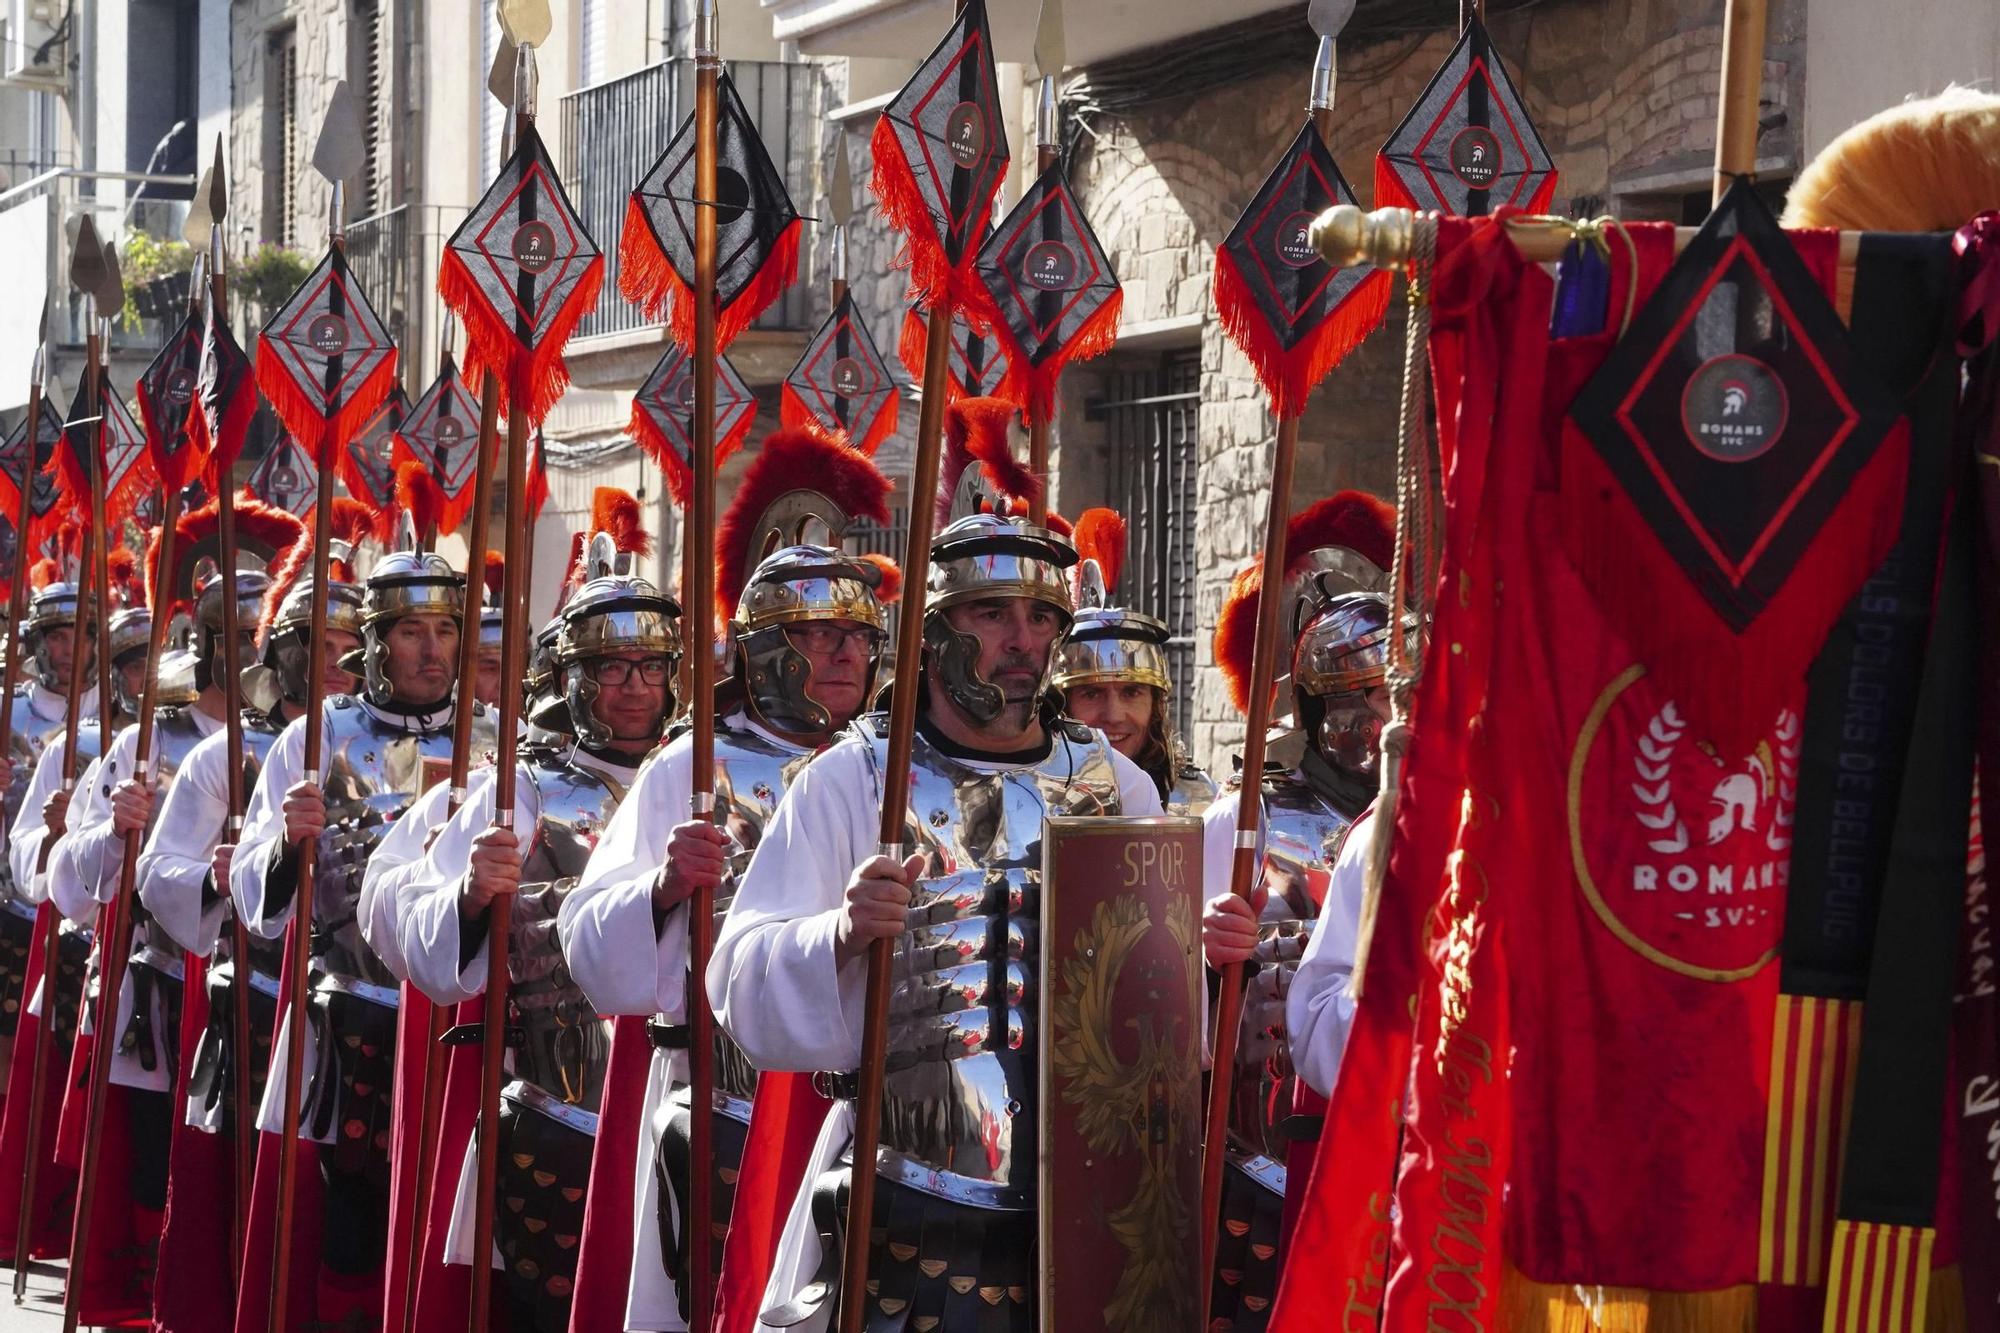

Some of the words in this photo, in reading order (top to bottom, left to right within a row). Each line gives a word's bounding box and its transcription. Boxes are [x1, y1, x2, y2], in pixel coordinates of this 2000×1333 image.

[951, 141, 976, 155] ROMANS
[1460, 166, 1492, 175] ROMANS
[1283, 246, 1314, 255] ROMANS
[1034, 272, 1064, 281] ROMANS
[1700, 422, 1763, 436] ROMANS
[1721, 437, 1744, 446] SVC
[1123, 841, 1186, 892] SPQR
[1822, 799, 1870, 941] BELLPUIG
[1633, 860, 1789, 895] ROMANS
